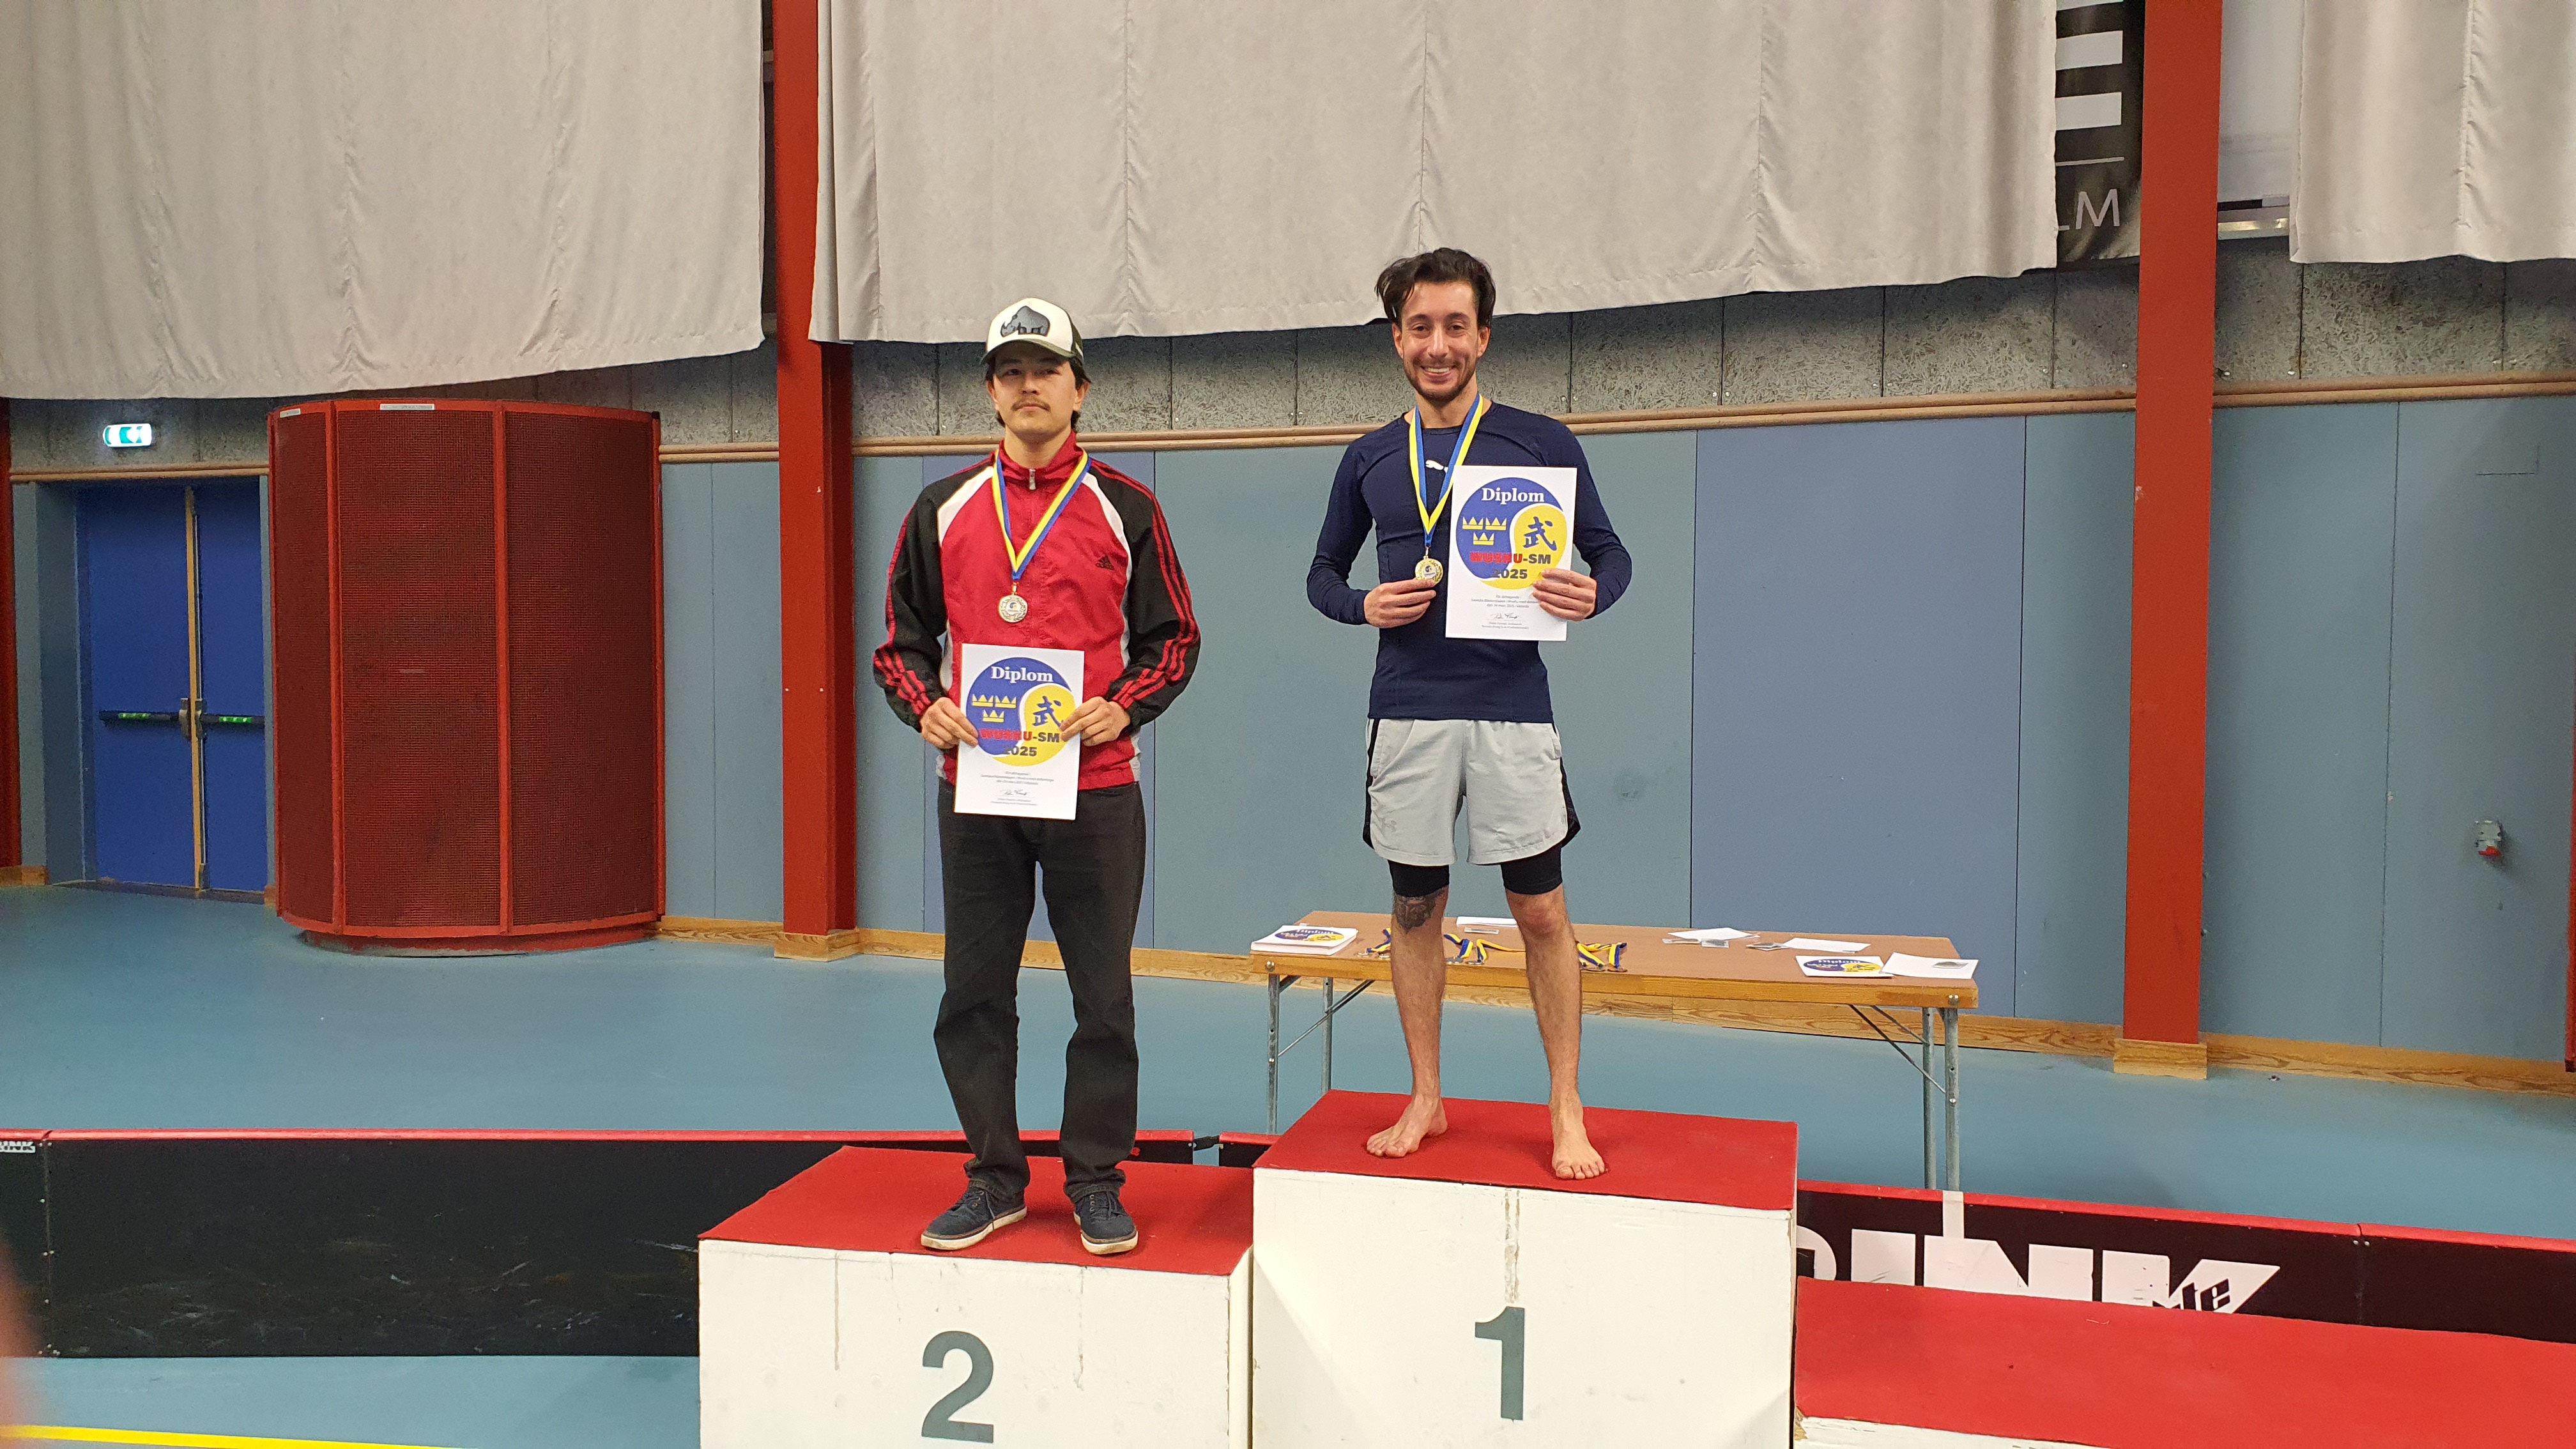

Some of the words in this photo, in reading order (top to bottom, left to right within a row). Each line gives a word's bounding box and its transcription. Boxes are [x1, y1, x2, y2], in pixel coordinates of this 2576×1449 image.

[2058, 188, 2120, 231] M
[1481, 487, 1545, 505] Diplom
[1522, 516, 1558, 551] 武
[1469, 552, 1551, 564] WUSHU-SM
[1491, 569, 1528, 579] 2025
[991, 666, 1054, 683] Diplom
[1032, 695, 1063, 726] 武
[979, 728, 1060, 742] WUSHU-SM
[1002, 746, 1038, 756] 2025
[1474, 1305, 1526, 1421] 1
[921, 1330, 995, 1444] 2
